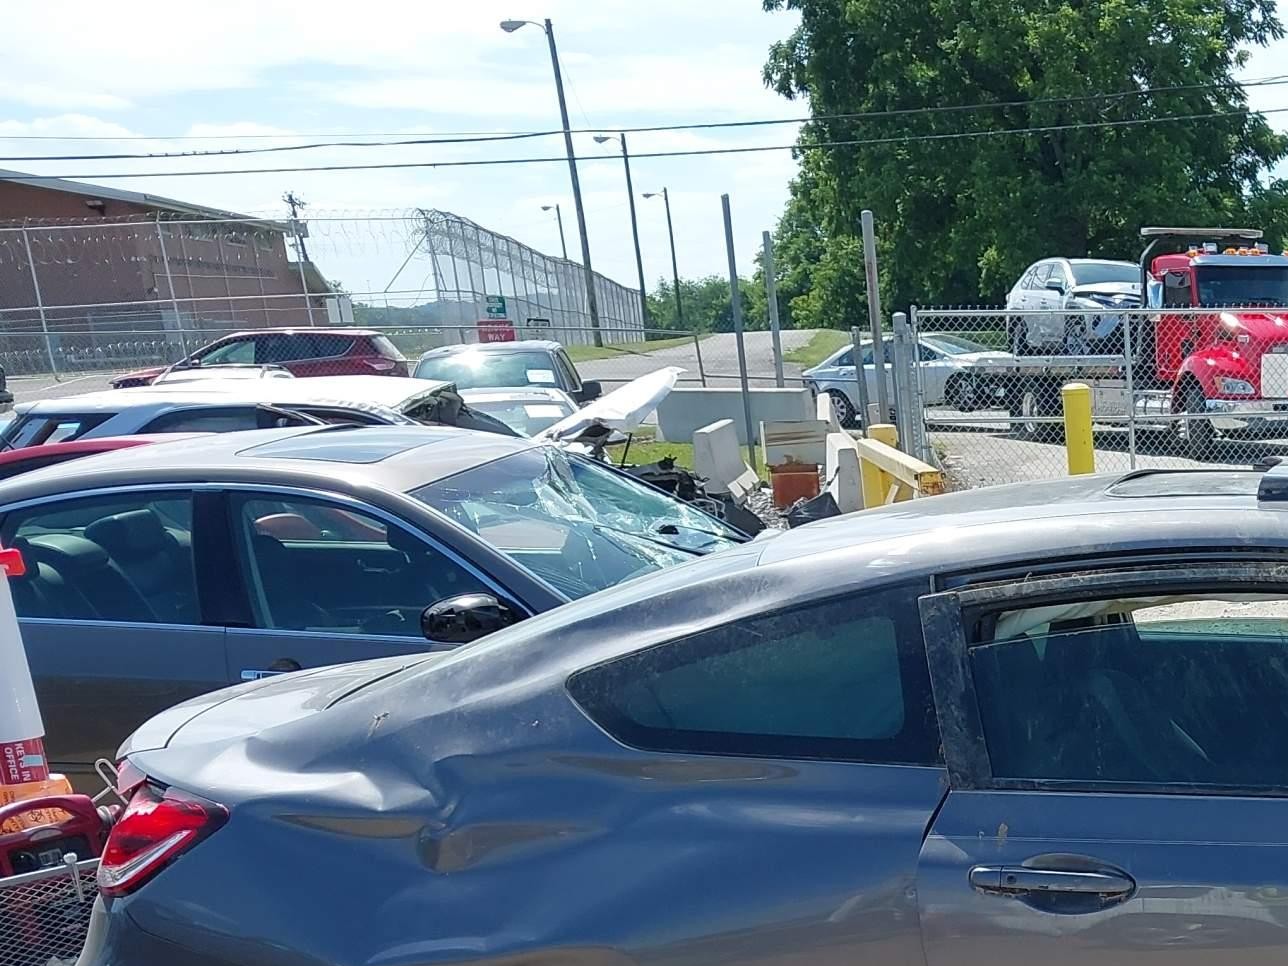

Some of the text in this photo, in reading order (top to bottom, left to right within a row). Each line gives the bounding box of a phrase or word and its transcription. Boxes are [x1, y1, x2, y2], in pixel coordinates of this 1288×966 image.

[487, 333, 505, 341] WAY
[4, 747, 19, 781] OFFICE
[22, 771, 31, 781] IN
